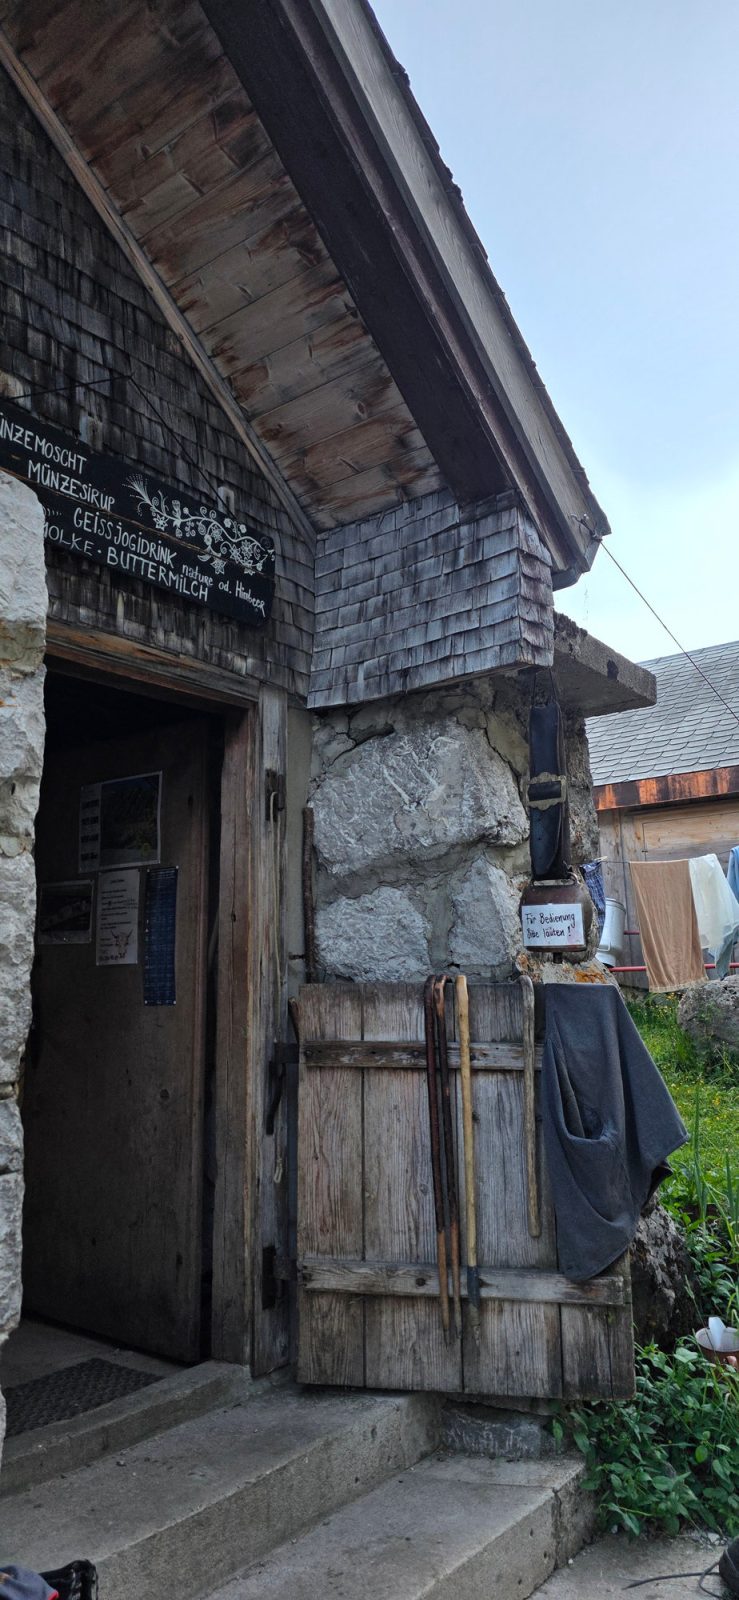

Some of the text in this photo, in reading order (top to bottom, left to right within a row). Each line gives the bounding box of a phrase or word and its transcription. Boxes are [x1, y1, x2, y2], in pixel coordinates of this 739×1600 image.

[218, 580, 232, 594] od.
[525, 912, 576, 928] Für Bedienung
